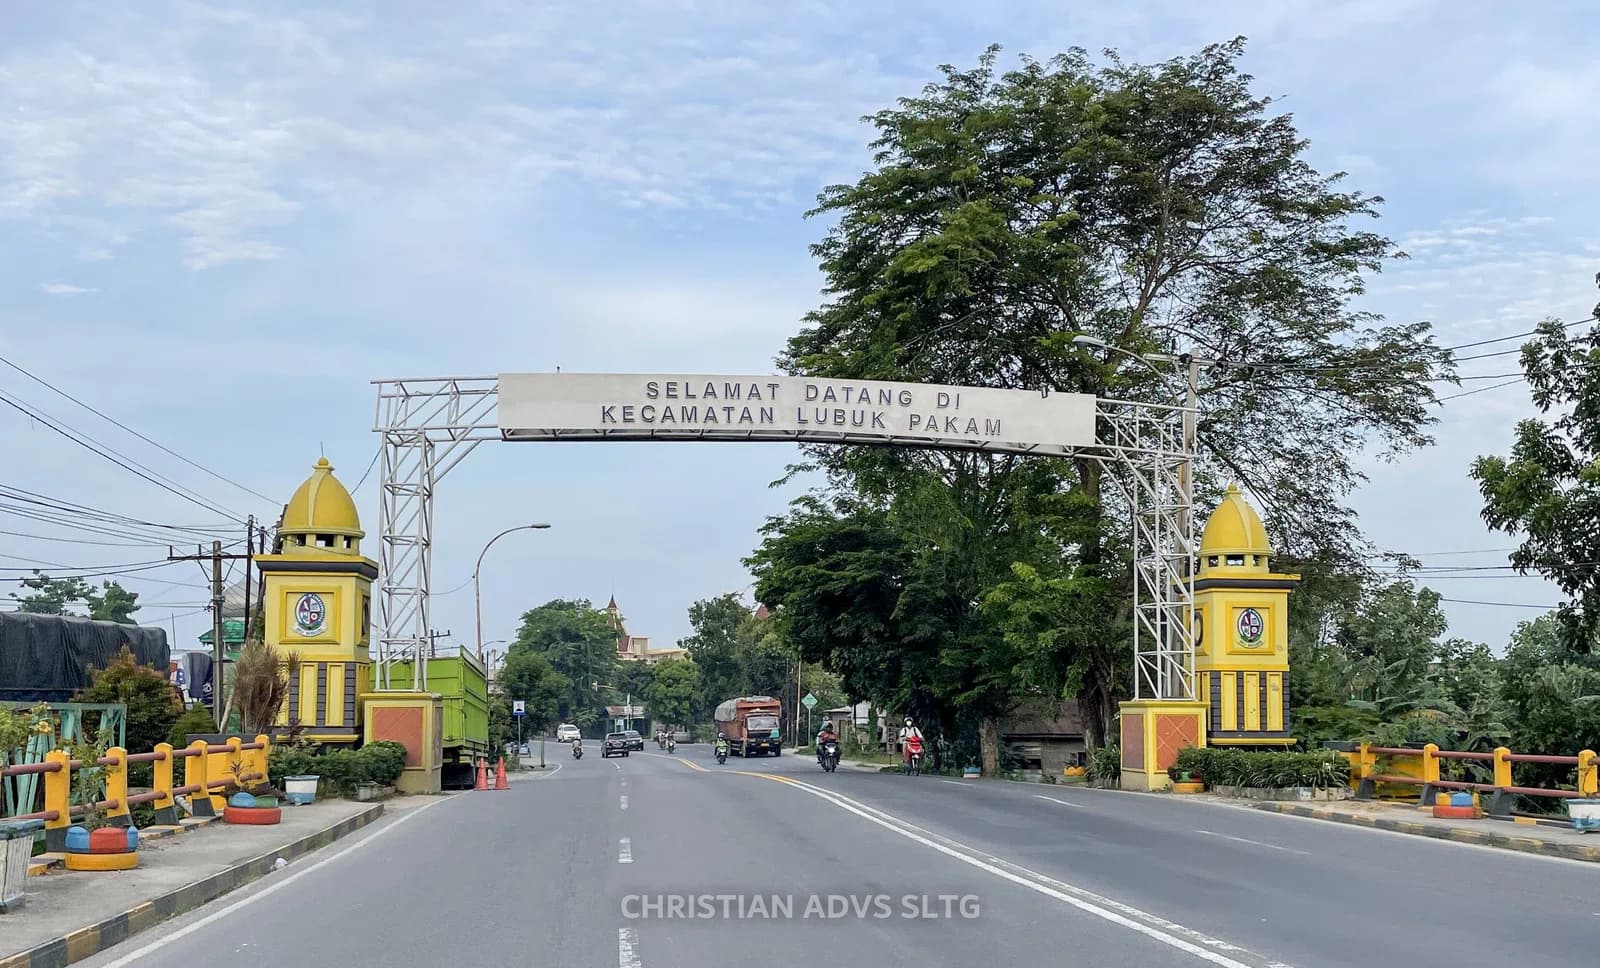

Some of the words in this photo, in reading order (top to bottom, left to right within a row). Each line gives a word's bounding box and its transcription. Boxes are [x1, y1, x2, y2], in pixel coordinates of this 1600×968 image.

[646, 382, 780, 400] SELAMAT
[805, 384, 912, 407] DATANG
[937, 392, 960, 409] DI
[602, 405, 774, 424] KECAMATAN
[797, 407, 885, 428] LUBUK
[909, 414, 1001, 435] PAKAM
